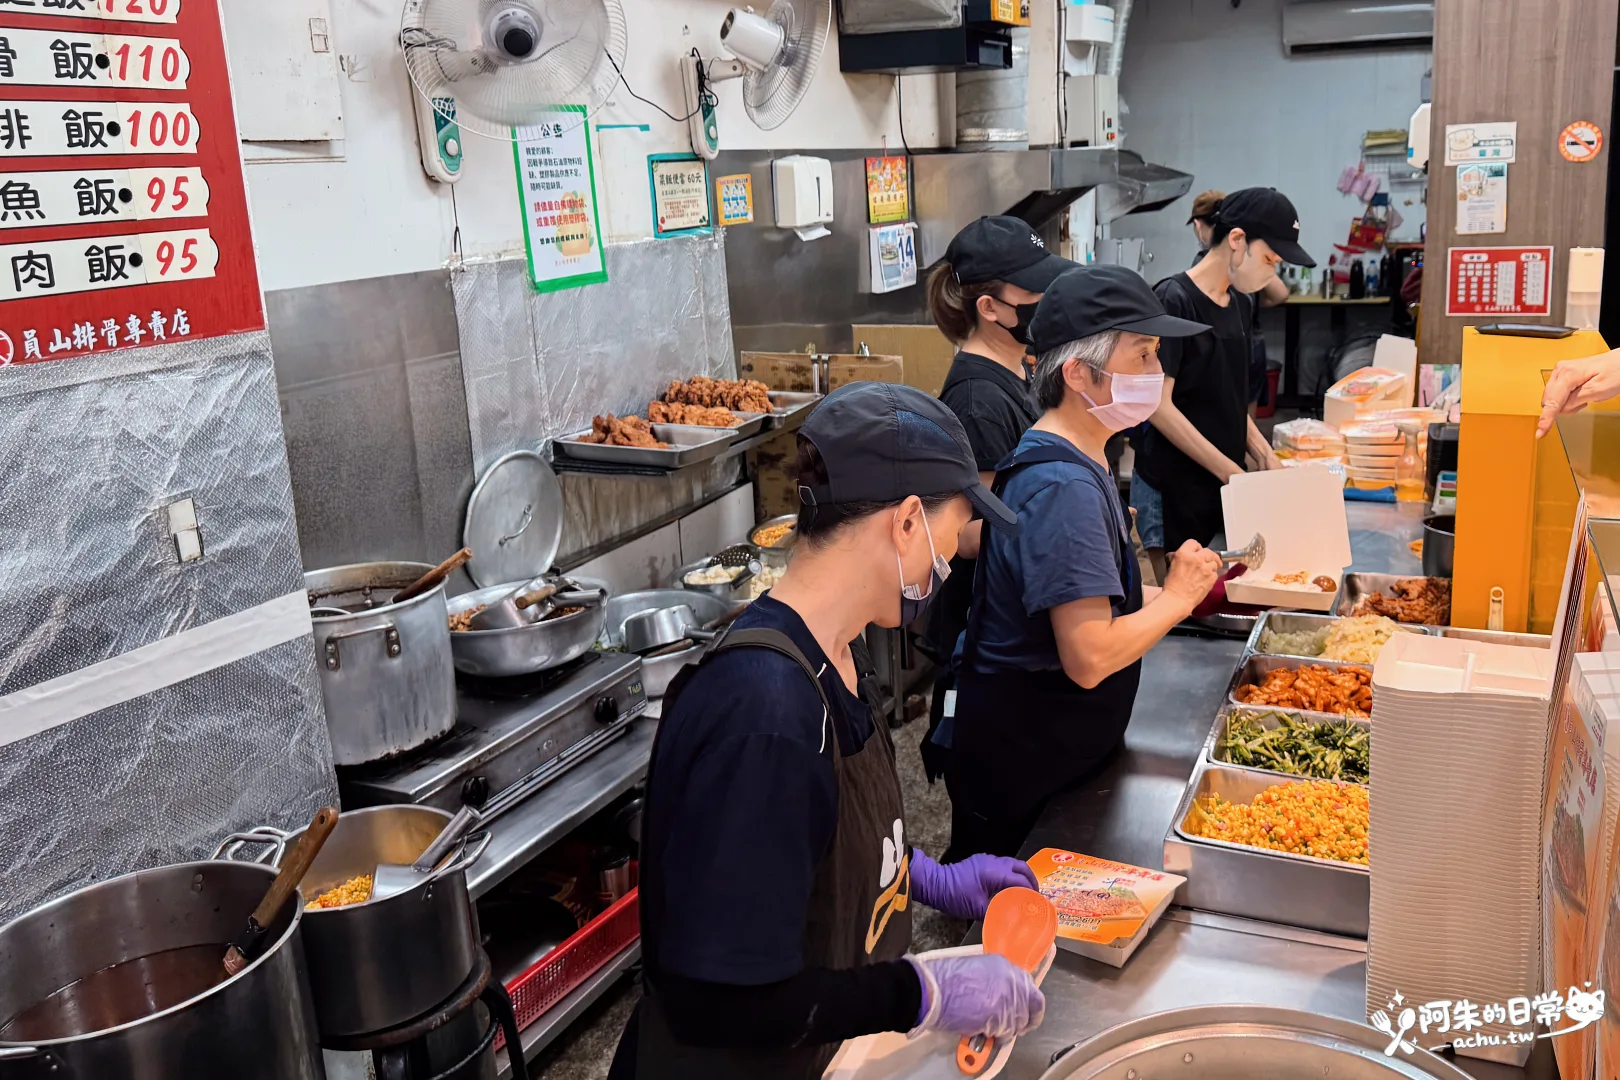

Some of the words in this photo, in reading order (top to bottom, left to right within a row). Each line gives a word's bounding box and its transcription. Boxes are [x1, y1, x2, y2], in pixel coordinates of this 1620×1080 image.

[116, 43, 181, 82] 110
[127, 109, 191, 148] 100
[540, 123, 563, 138] 公告
[147, 175, 190, 213] 95
[156, 237, 199, 277] 95
[898, 235, 914, 263] 14
[22, 308, 192, 361] 員山排骨專賣店
